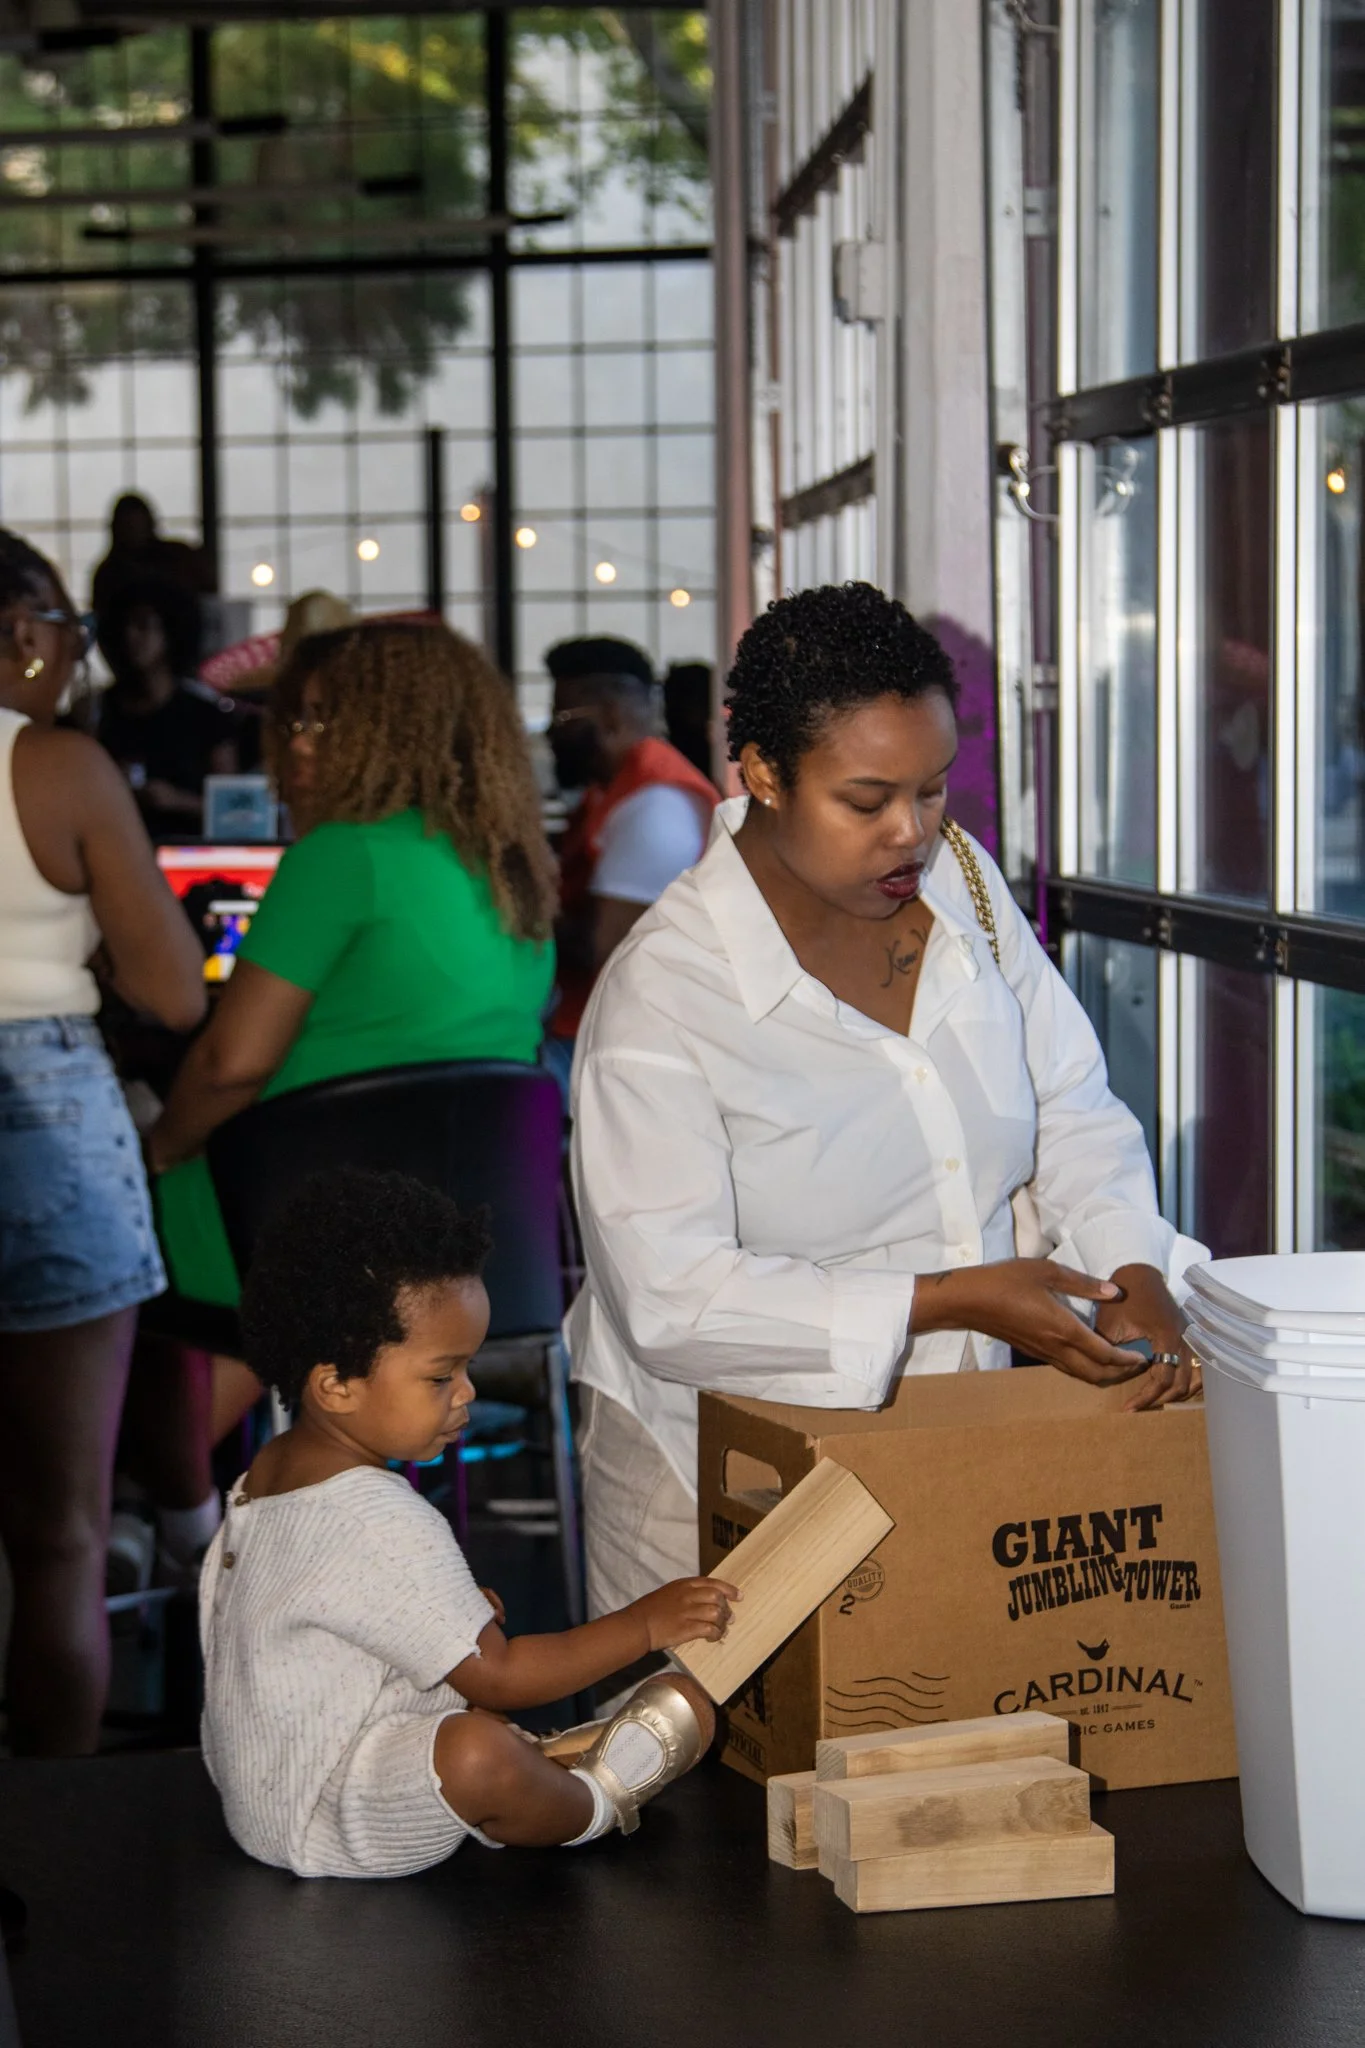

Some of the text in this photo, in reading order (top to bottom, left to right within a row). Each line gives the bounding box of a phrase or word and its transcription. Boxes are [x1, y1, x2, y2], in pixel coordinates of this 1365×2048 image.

[992, 1504, 1163, 1568] GIANT
[847, 1571, 882, 1588] QUALITY
[1008, 1552, 1201, 1621] JUMBLING TOWER
[993, 1666, 1193, 1715] CARDINAL
[1103, 1719, 1155, 1733] GAMES
